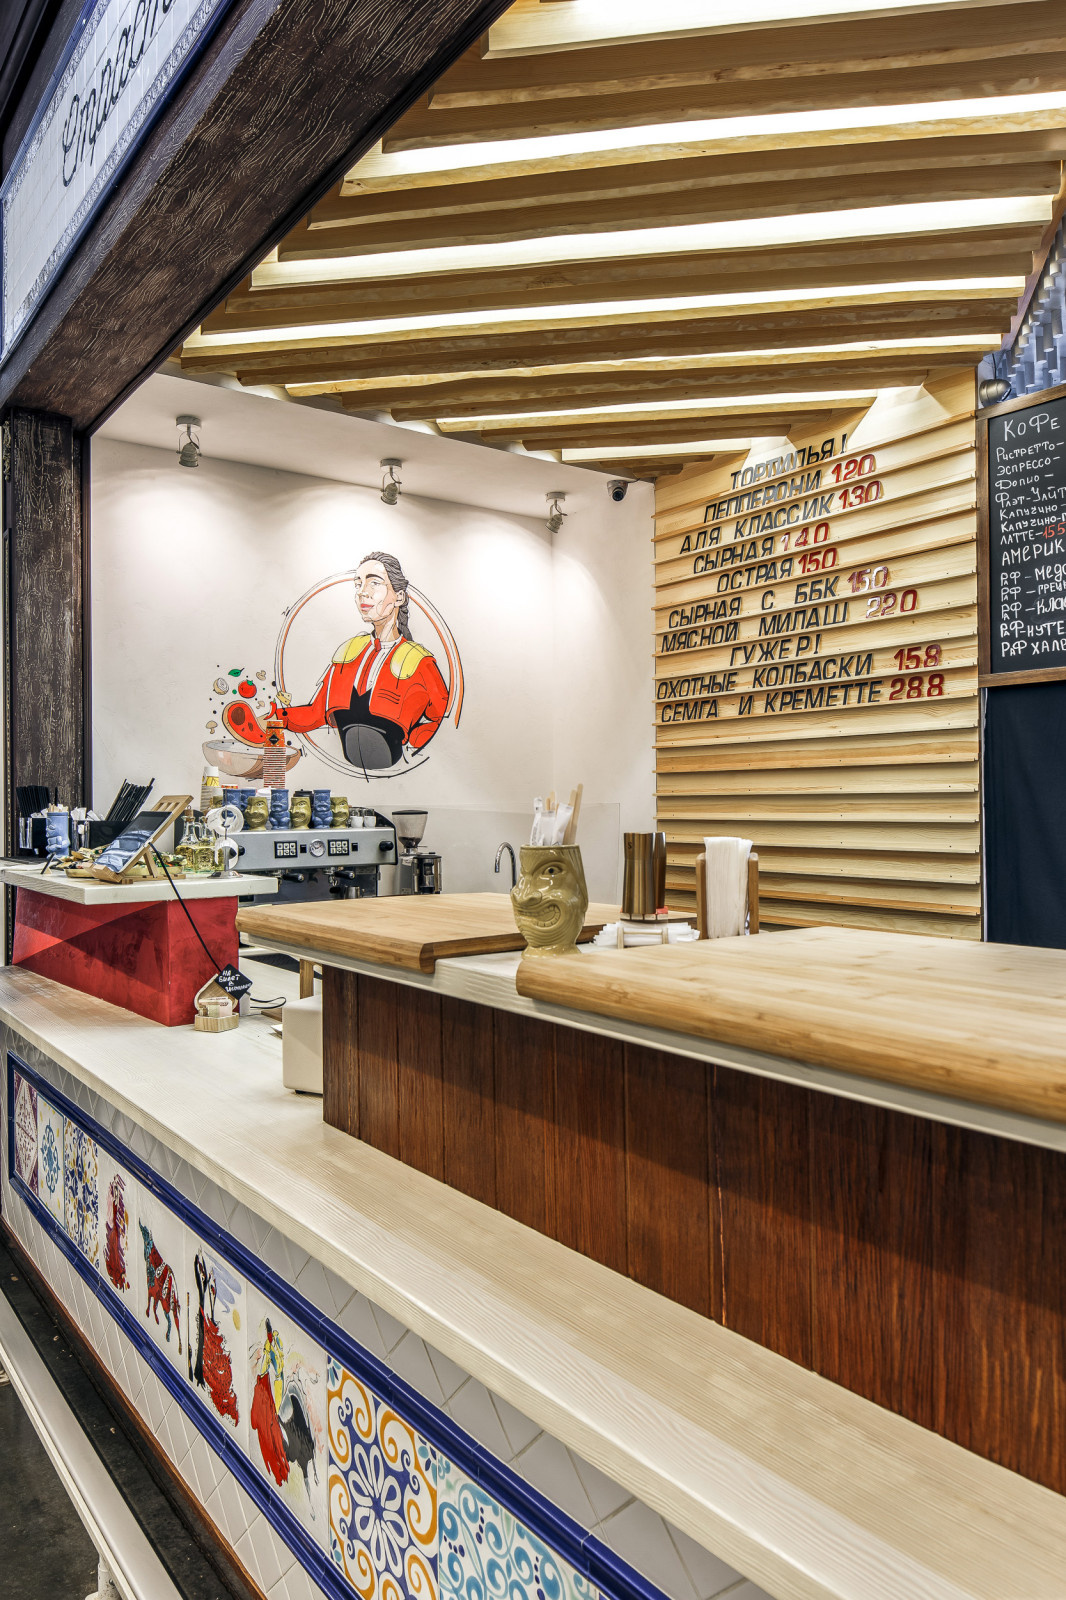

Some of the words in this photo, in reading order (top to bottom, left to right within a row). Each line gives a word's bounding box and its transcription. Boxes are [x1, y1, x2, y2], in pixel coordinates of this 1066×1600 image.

[680, 526, 721, 554] АЛЯ
[734, 493, 835, 537] КЛАССИК
[839, 480, 881, 510] 130
[703, 470, 823, 523] ПЕППЕРОНИ
[831, 454, 875, 484] 120
[693, 537, 774, 575] СЫРНАЯ
[780, 522, 829, 552] 140
[716, 558, 794, 593] ОСТРАЯ
[798, 547, 838, 574] 150
[661, 622, 740, 653] МЯСНОЙ
[758, 602, 848, 636] МИЛАШ
[865, 589, 918, 619] 220
[668, 597, 742, 629] СЫРНАЯ
[761, 590, 775, 610] С
[795, 576, 840, 604] ББК
[847, 566, 889, 592] 150
[657, 672, 736, 700] ОХОТНЫЕ
[752, 653, 872, 689] КОЛБАСКИ
[894, 644, 942, 671] 158
[661, 699, 718, 723] СЕМГА
[738, 695, 754, 716] И
[765, 680, 882, 713] КРЕМЕТТЕ
[889, 674, 945, 701] 288
